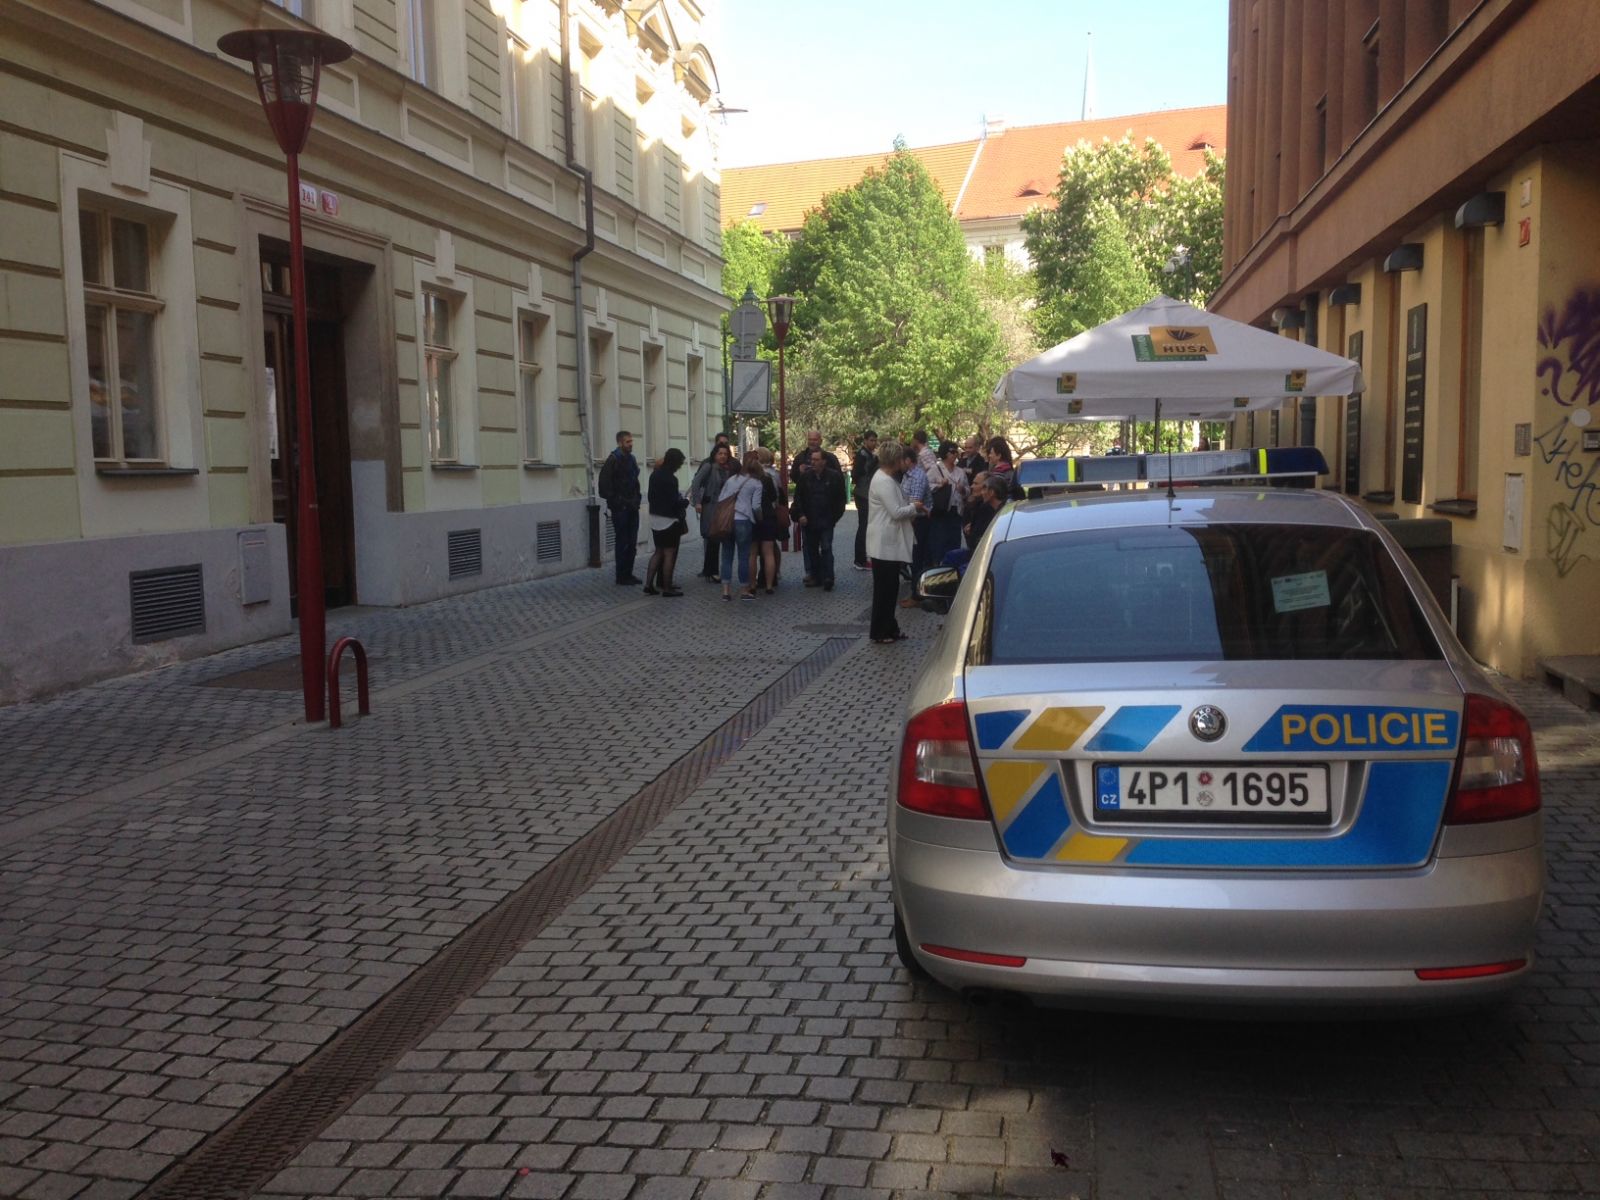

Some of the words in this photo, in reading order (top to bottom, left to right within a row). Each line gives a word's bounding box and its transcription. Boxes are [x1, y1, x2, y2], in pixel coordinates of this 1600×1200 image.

[1163, 345, 1209, 353] HUSA
[1281, 712, 1449, 745] POLICIE
[1101, 794, 1118, 805] CZ
[1127, 771, 1189, 805] 4P1
[1222, 771, 1309, 807] 1695
